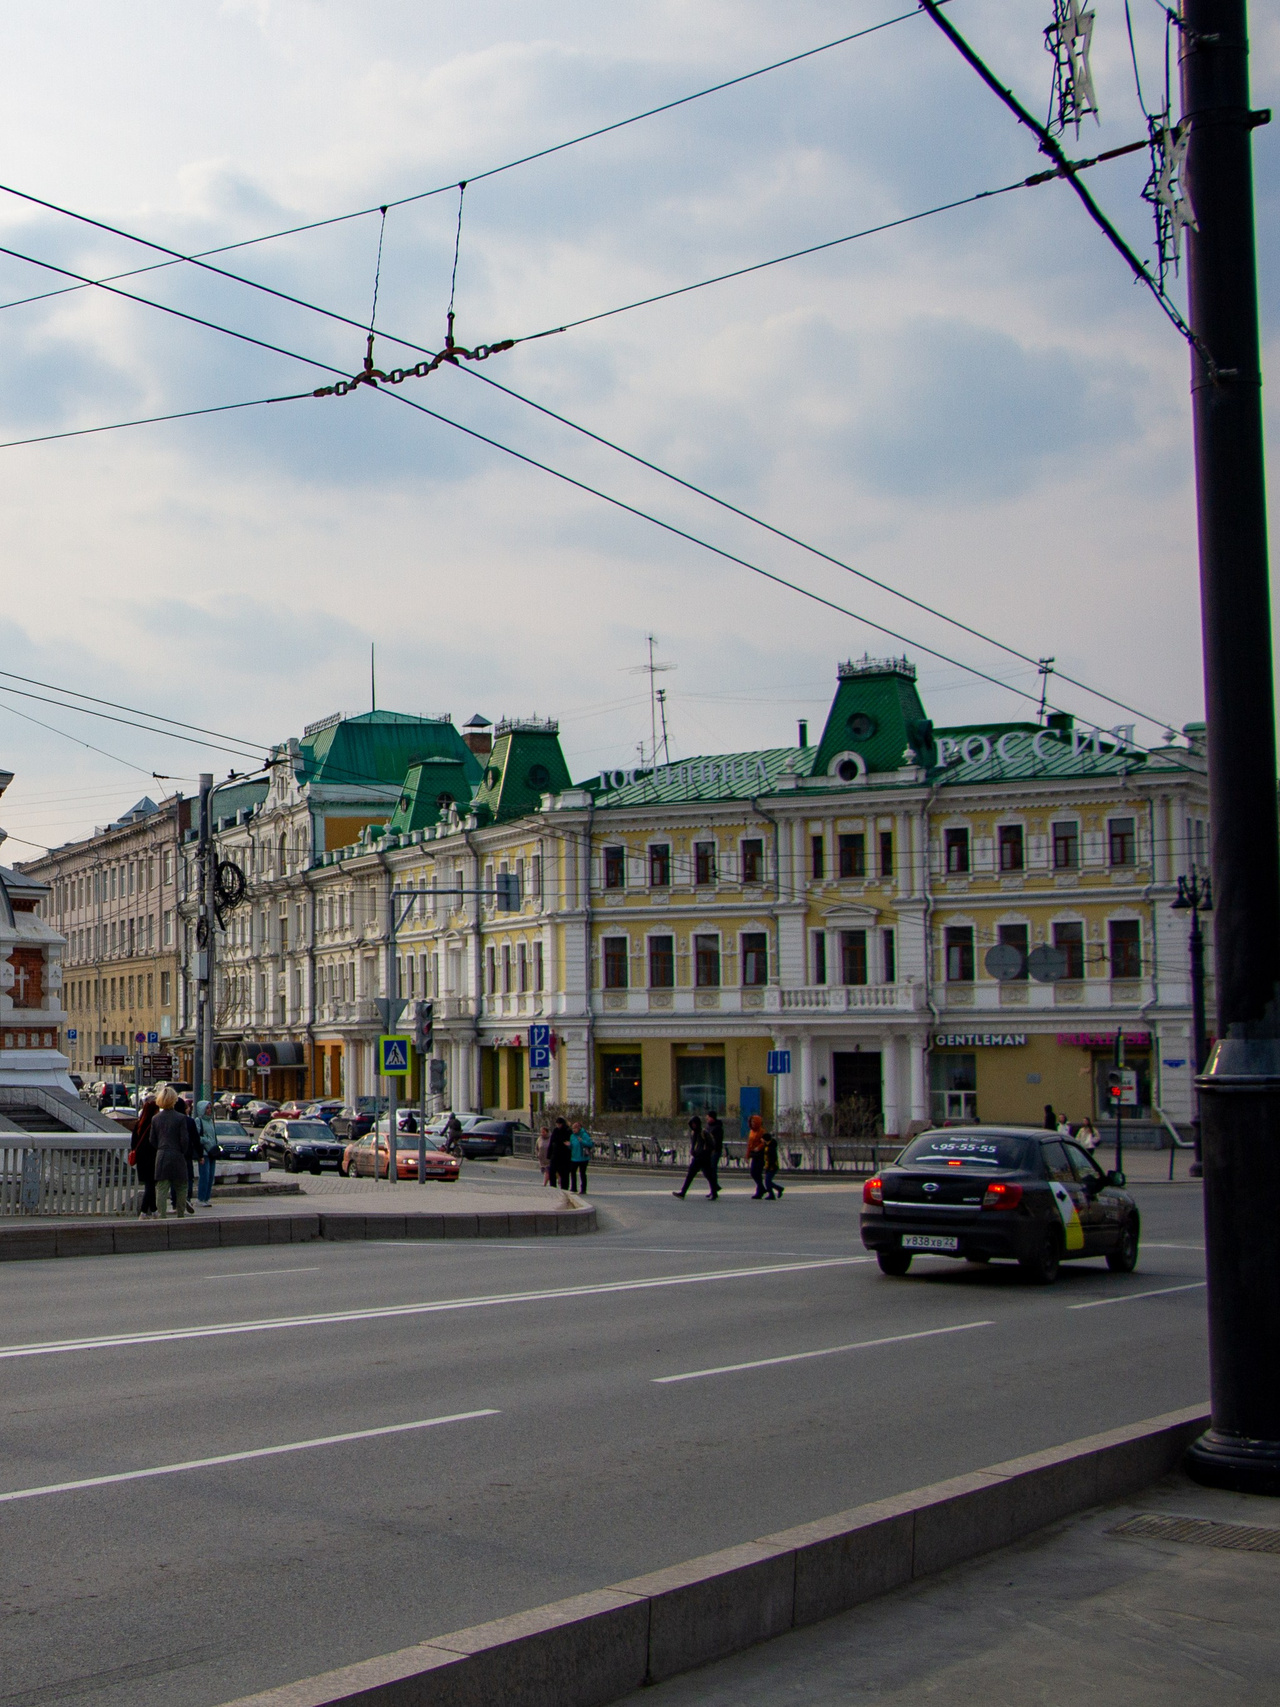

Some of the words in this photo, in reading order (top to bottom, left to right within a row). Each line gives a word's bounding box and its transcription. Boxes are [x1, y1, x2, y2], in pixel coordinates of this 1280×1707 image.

[934, 724, 1136, 768] РОССИЯ
[599, 758, 768, 789] ГОСТИНИЦА
[936, 1034, 1026, 1046] GENTLEMAN
[939, 1143, 997, 1153] 95-55-55
